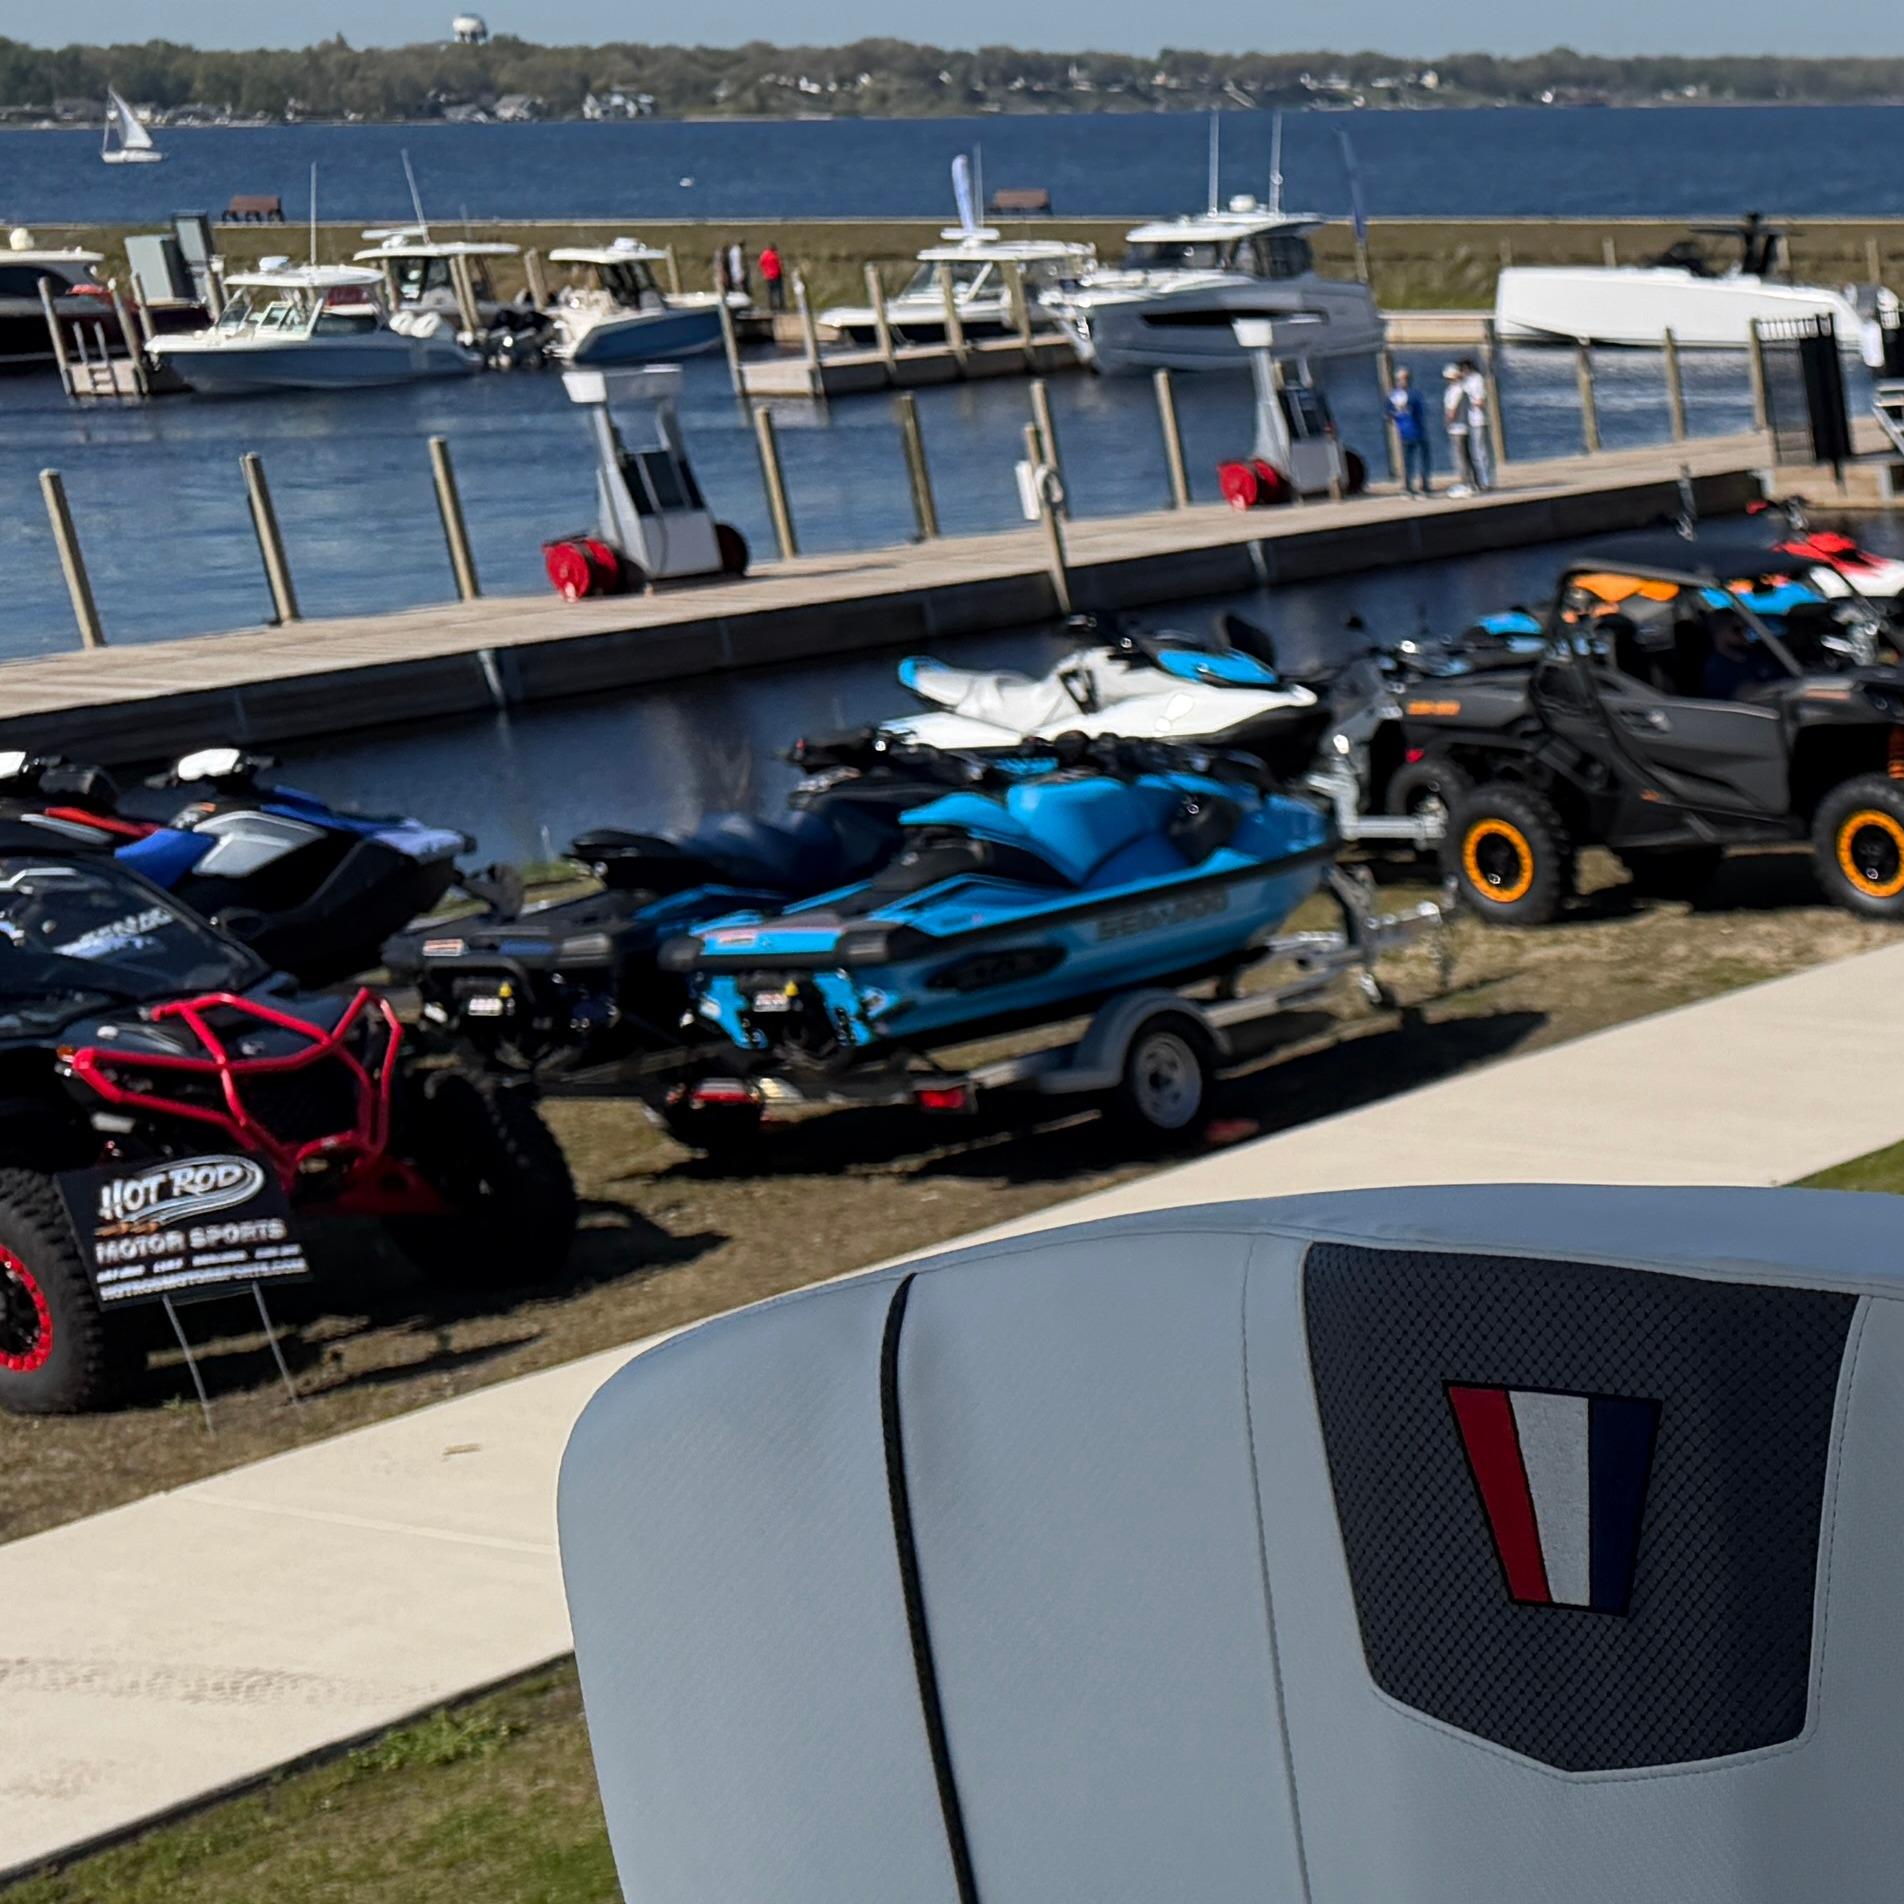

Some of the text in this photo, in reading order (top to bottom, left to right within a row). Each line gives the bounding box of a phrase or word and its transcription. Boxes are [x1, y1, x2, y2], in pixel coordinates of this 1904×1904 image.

[98, 1163, 245, 1219] HOT ROD
[95, 1230, 187, 1264] MOTOR
[189, 1217, 288, 1249] SPORTS
